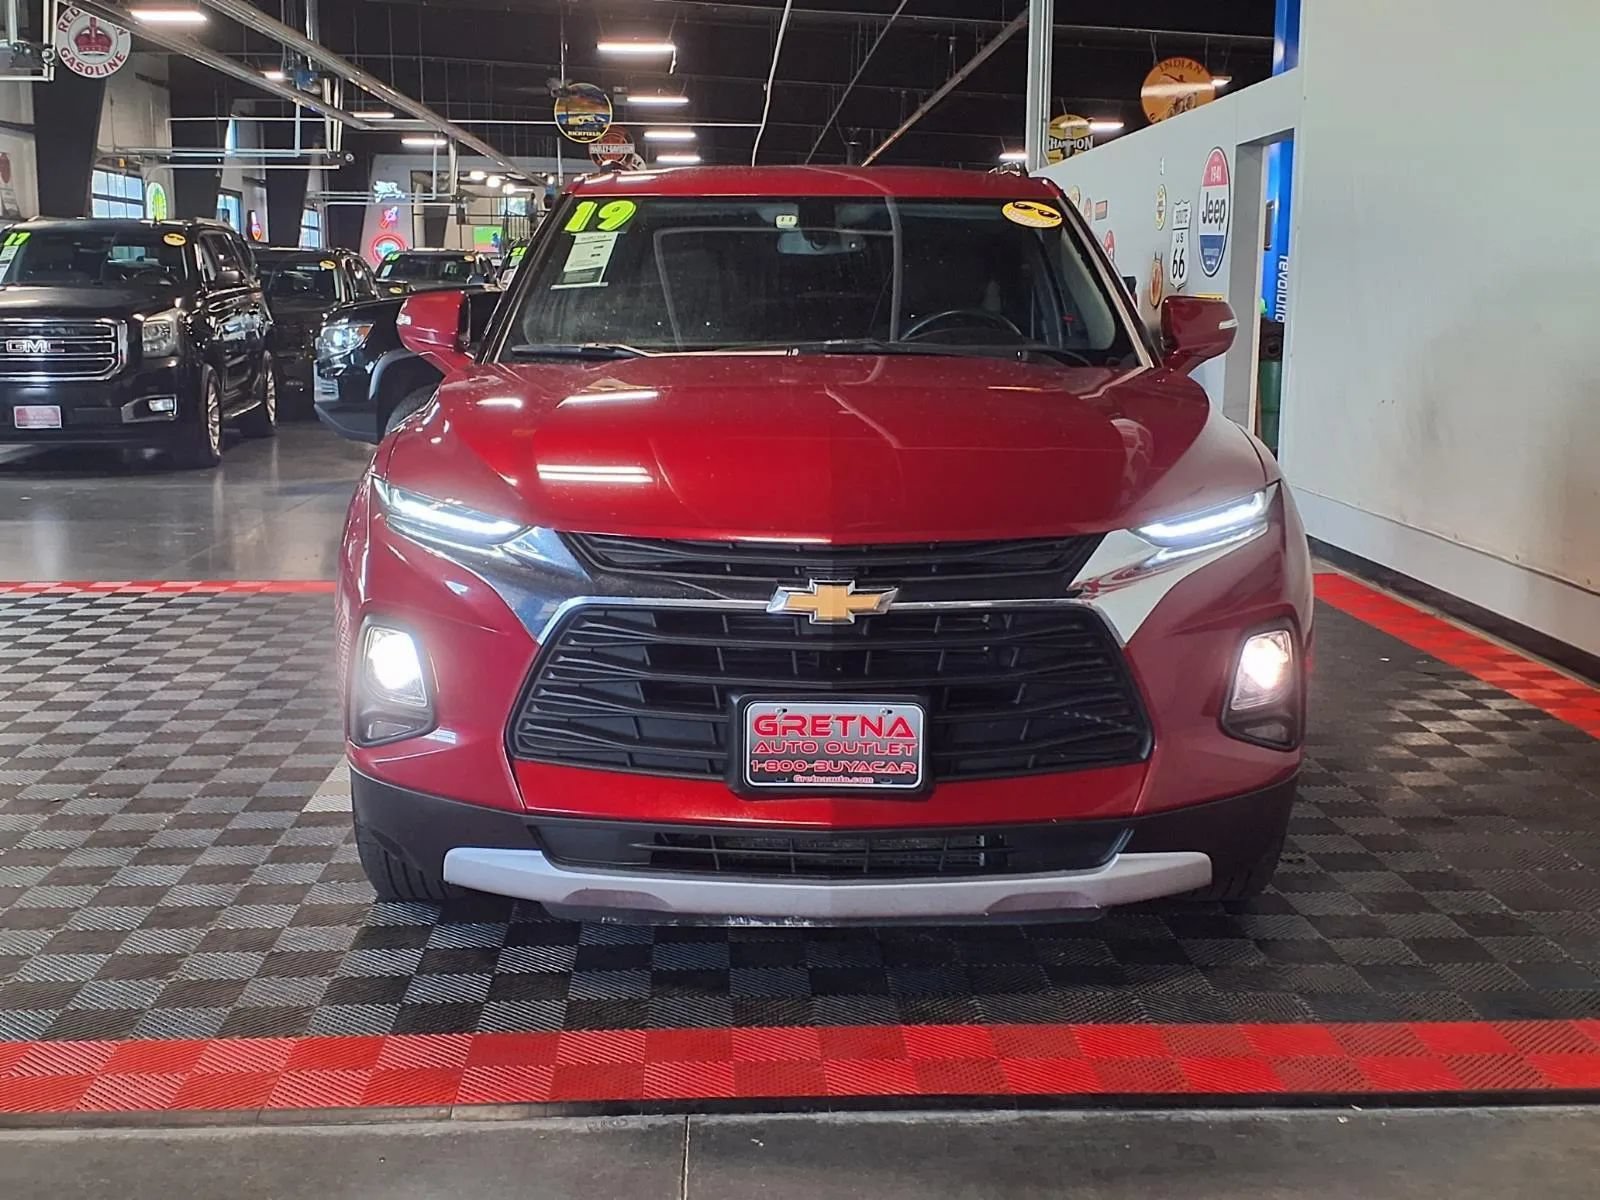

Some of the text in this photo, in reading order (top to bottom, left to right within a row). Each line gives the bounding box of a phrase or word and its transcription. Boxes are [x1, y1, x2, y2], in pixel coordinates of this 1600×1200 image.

[58, 8, 81, 33] RED
[60, 47, 126, 76] GASOLINE
[1160, 59, 1203, 75] INDIAN
[1048, 134, 1095, 151] HAMPION
[564, 200, 637, 232] 19
[1202, 191, 1226, 231] Jeep
[1175, 232, 1184, 243] US
[1171, 248, 1185, 279] 66
[6, 340, 65, 353] GMC
[752, 713, 917, 739] GRETNA
[752, 740, 918, 756] AUTO OUTLET
[751, 759, 917, 774] 1-800-BUYACAR
